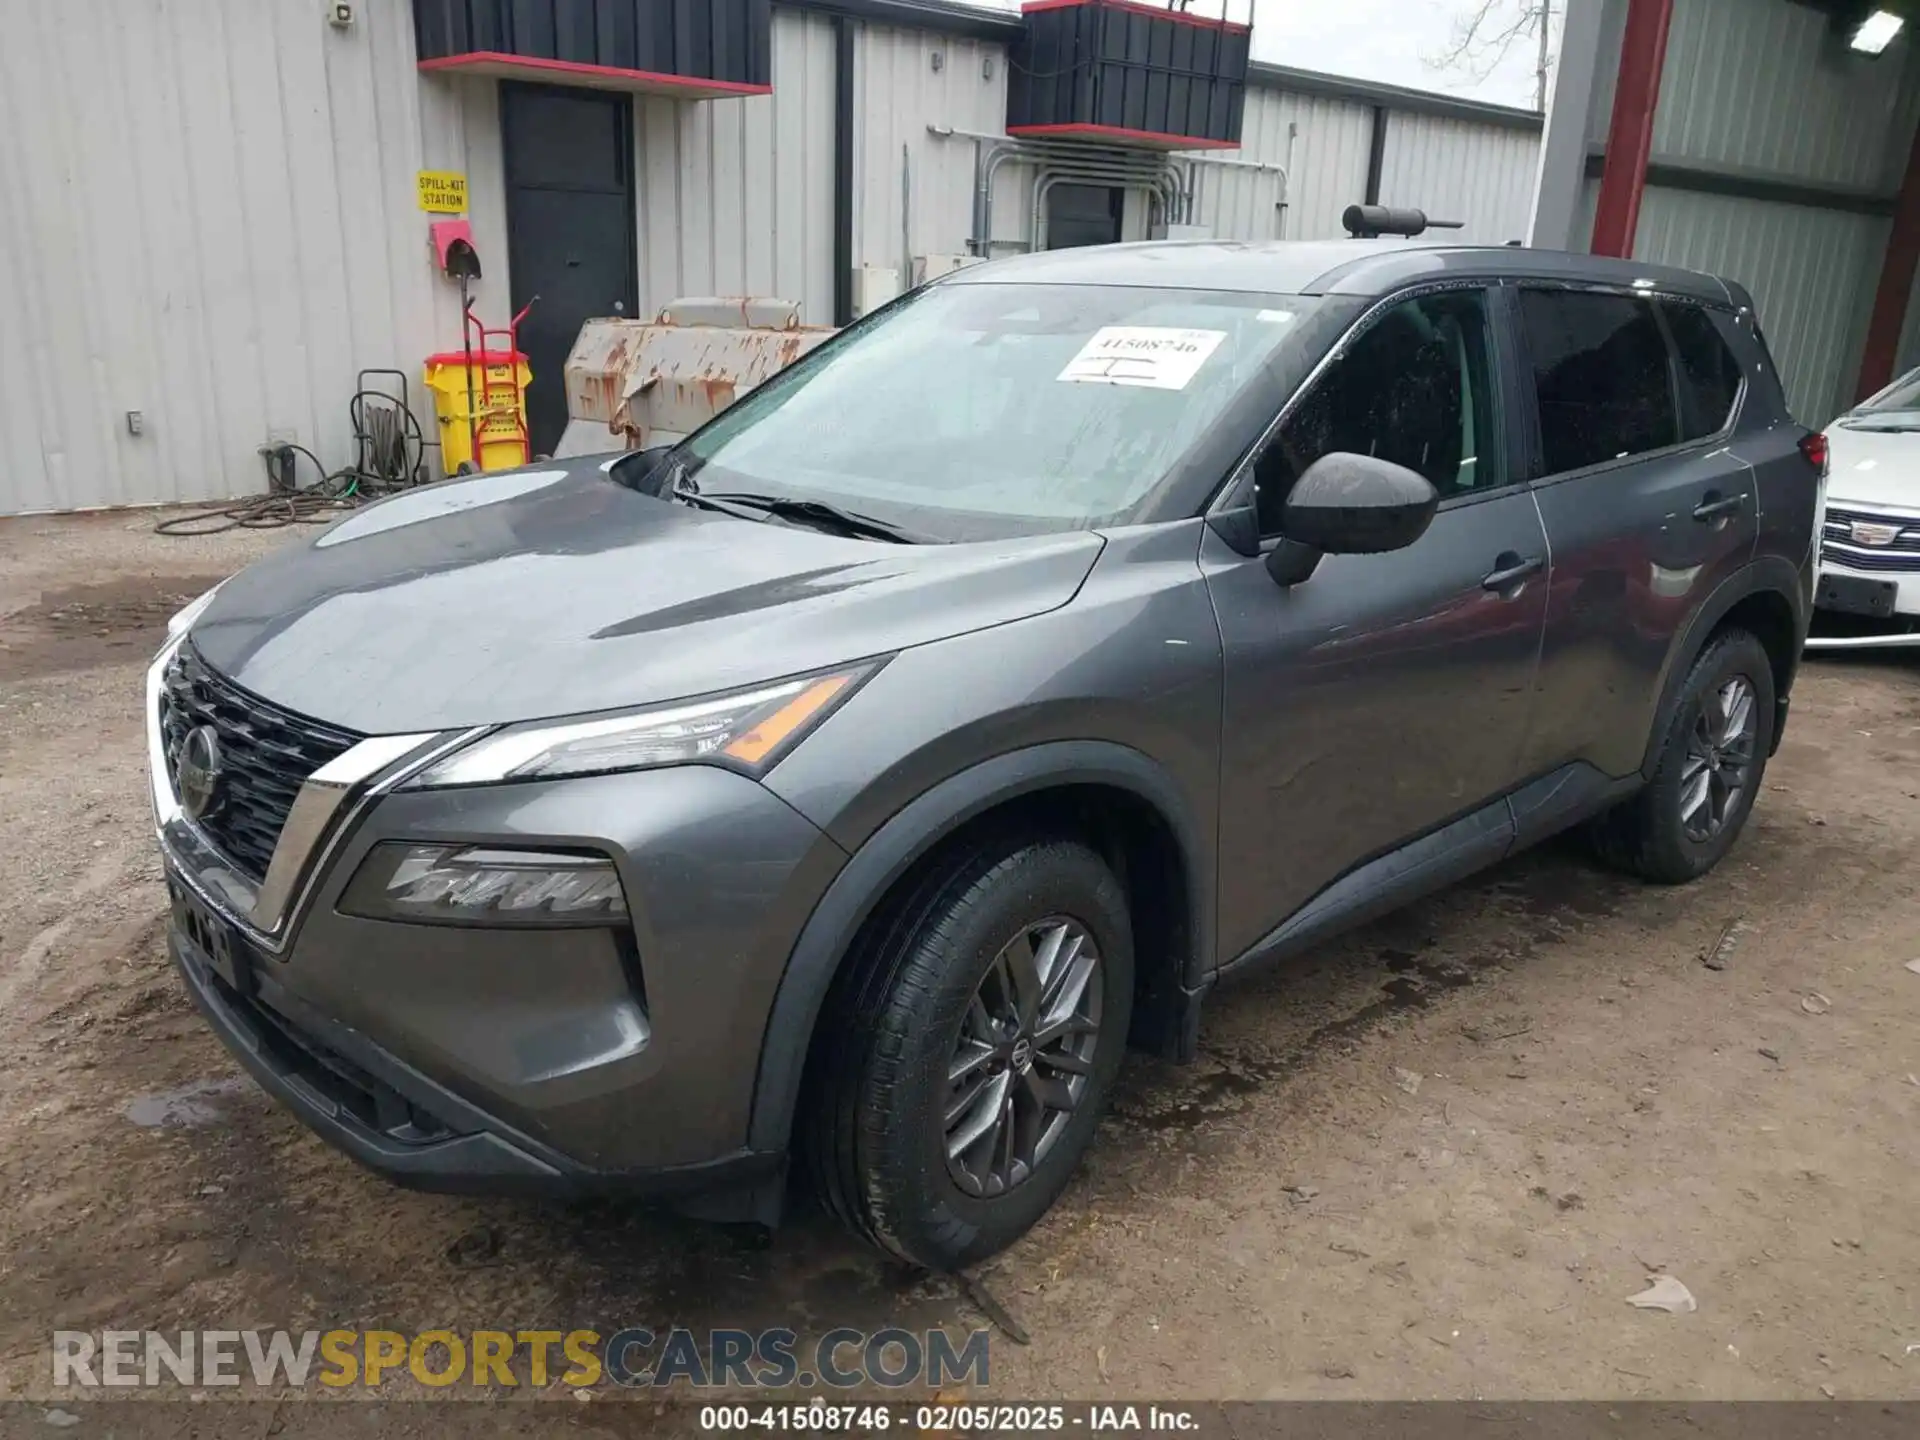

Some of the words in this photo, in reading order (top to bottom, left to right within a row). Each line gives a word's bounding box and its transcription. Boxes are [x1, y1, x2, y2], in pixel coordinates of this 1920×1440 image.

[419, 176, 465, 190] SPILL-KIT
[423, 193, 463, 206] STATION
[1098, 338, 1198, 353] 41508746
